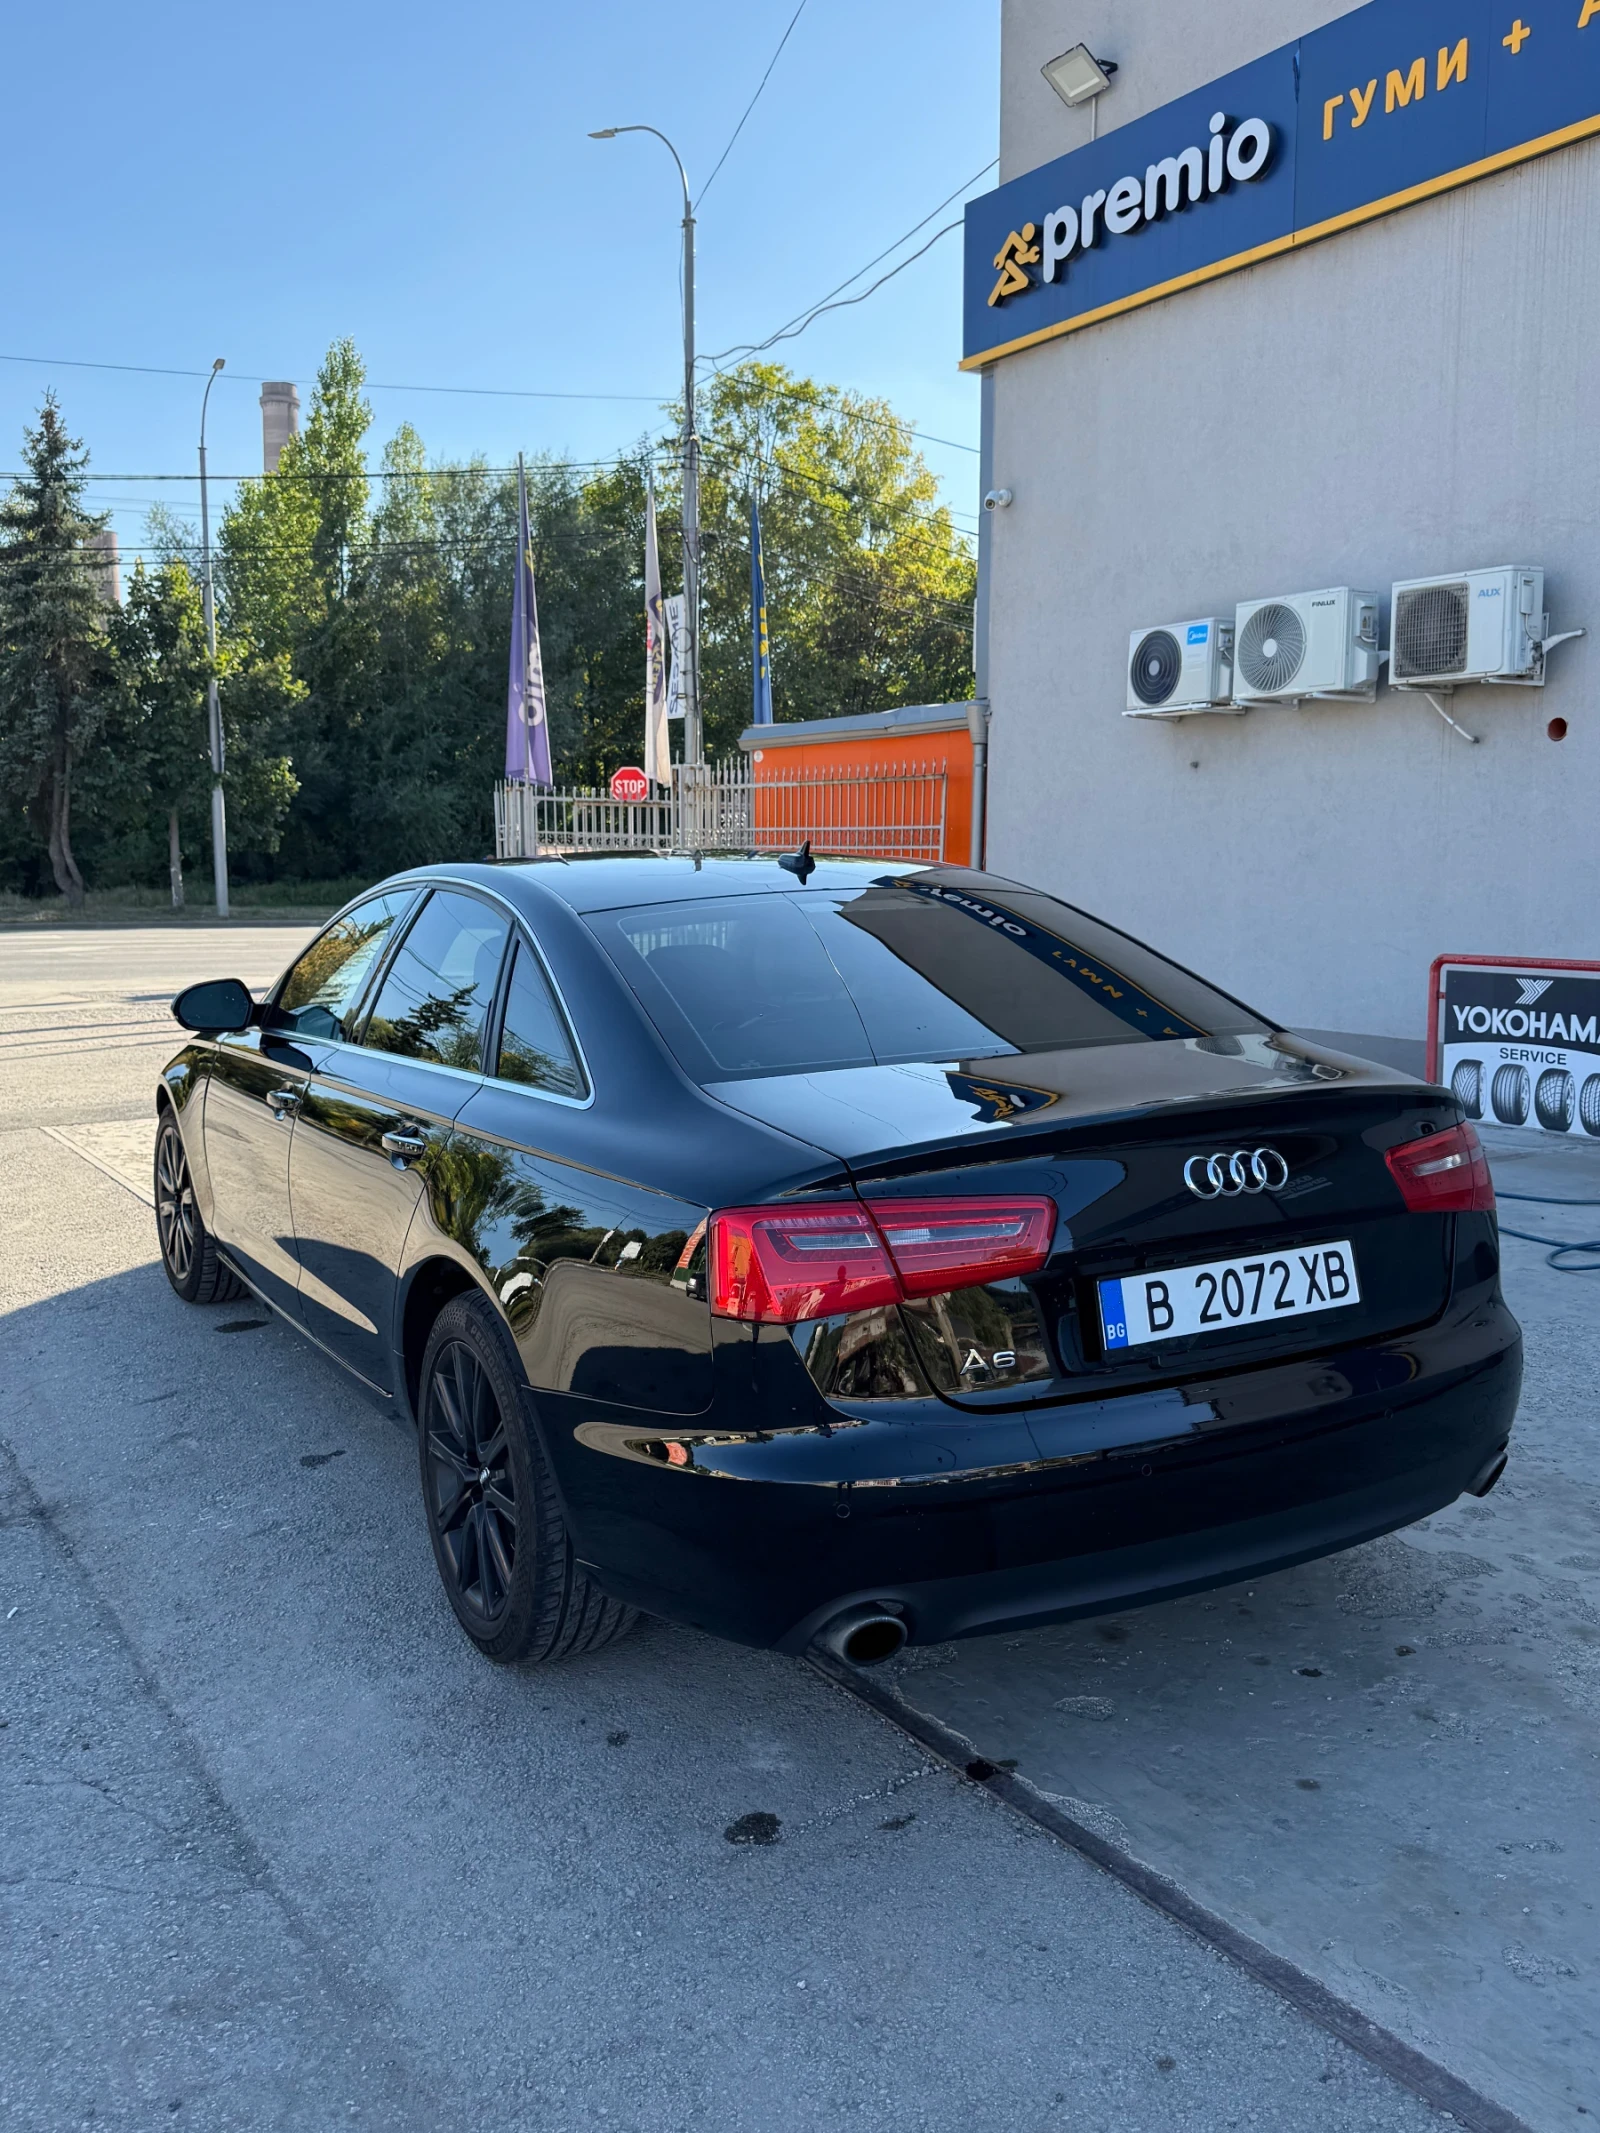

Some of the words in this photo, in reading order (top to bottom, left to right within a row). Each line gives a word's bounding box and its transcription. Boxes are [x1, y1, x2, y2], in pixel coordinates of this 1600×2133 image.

[1322, 37, 1470, 141] ГУМИ
[1043, 111, 1272, 284] premio
[1478, 588, 1501, 598] AUX
[615, 780, 645, 794] STOP
[1500, 1047, 1568, 1066] SERVICE
[1146, 1280, 1174, 1333] B
[1196, 1259, 1296, 1324] 2072
[1299, 1249, 1350, 1304] XB
[1106, 1322, 1126, 1341] BG
[960, 1349, 1016, 1376] A6
